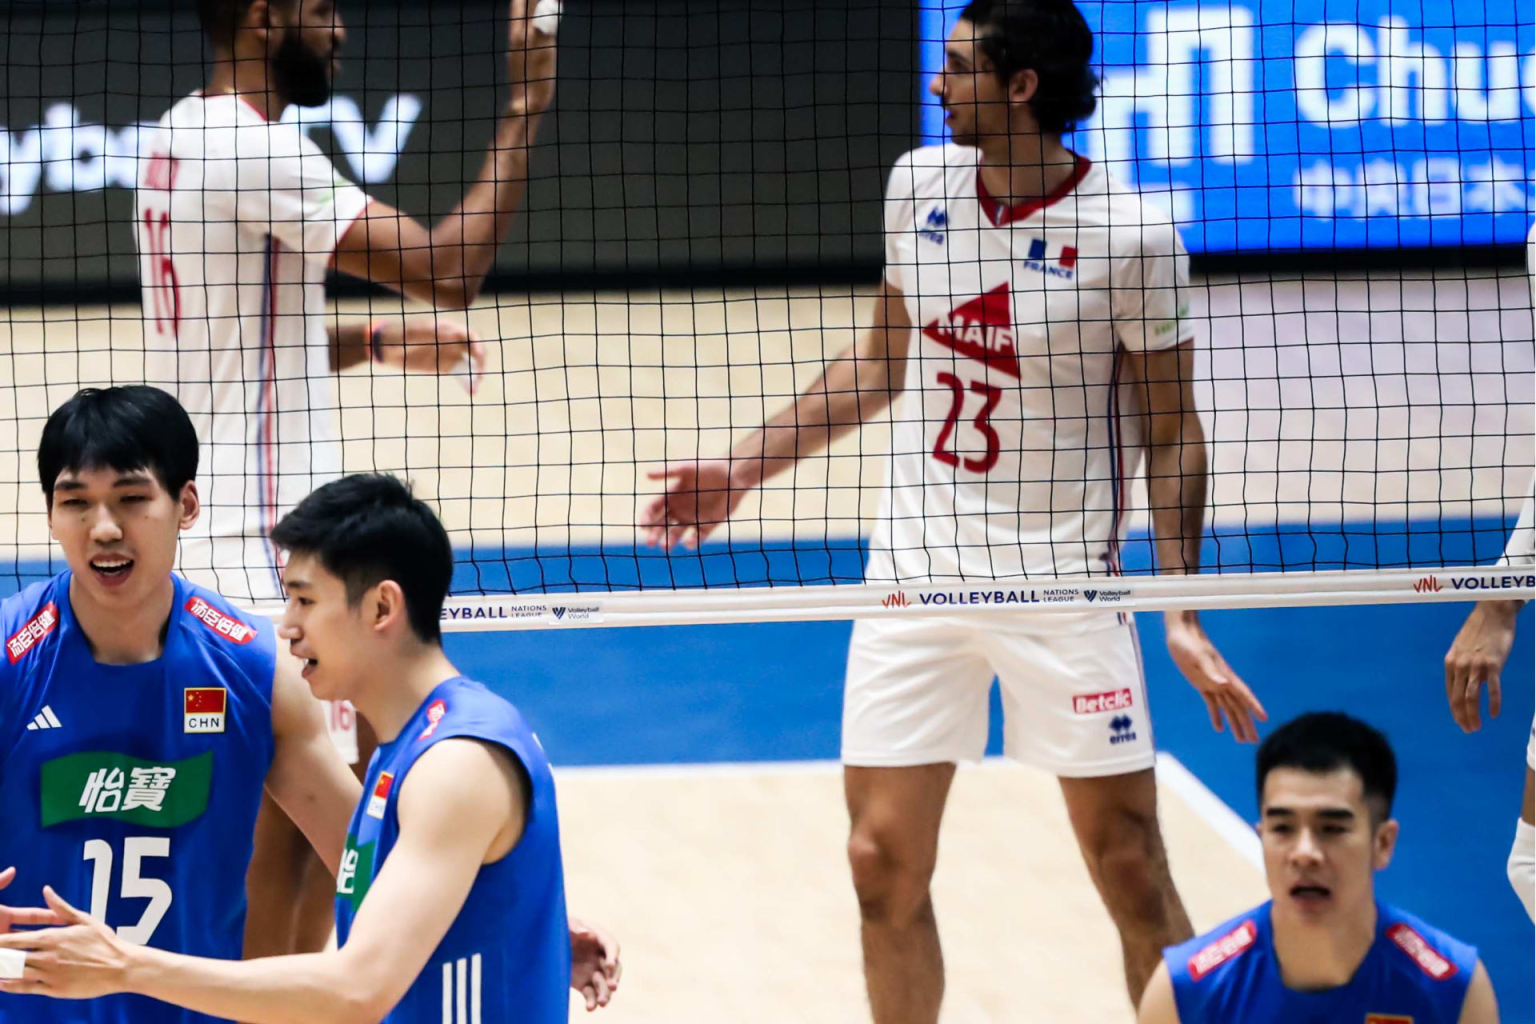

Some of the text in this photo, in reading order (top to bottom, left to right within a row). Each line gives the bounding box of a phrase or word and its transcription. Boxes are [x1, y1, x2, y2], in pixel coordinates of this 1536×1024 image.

[1294, 14, 1535, 129] Chu
[1023, 260, 1074, 281] FRANCE
[936, 313, 1013, 353] MAIF
[932, 371, 1003, 474] 23
[1413, 574, 1535, 593] VNL VOLLEYB
[511, 604, 547, 612] NATIONS
[882, 589, 1041, 609] VNL VOLLEYBALL
[439, 606, 508, 621] EYBALL
[188, 717, 221, 729] CHN
[78, 766, 177, 814] 怡寶
[83, 836, 173, 946] 15
